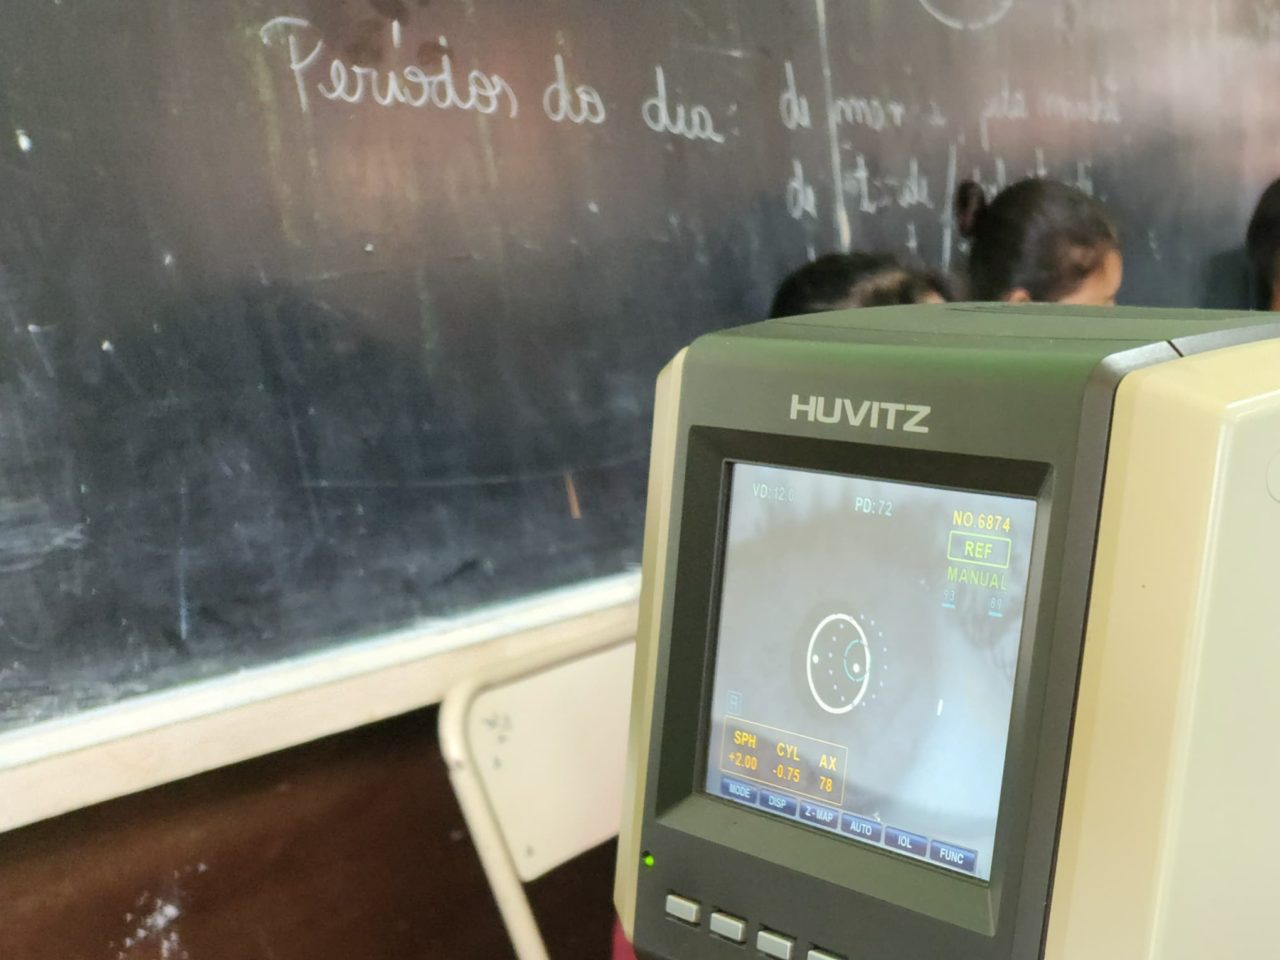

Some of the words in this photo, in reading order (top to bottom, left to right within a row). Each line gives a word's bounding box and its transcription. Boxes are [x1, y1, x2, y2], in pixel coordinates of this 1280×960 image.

[789, 394, 931, 433] HUVITZ
[963, 541, 993, 560] REF
[946, 566, 1008, 591] MANUAL
[733, 730, 757, 749] SPH
[776, 742, 800, 761] CYL
[819, 753, 837, 771] AX
[728, 752, 758, 771] +2.00
[772, 763, 800, 783] -0.75
[819, 775, 833, 793] 78
[728, 783, 751, 799] MODE
[767, 795, 787, 808] DISP
[850, 820, 873, 836] AUTO
[897, 834, 912, 849] IOL
[939, 847, 964, 864] FUNC
